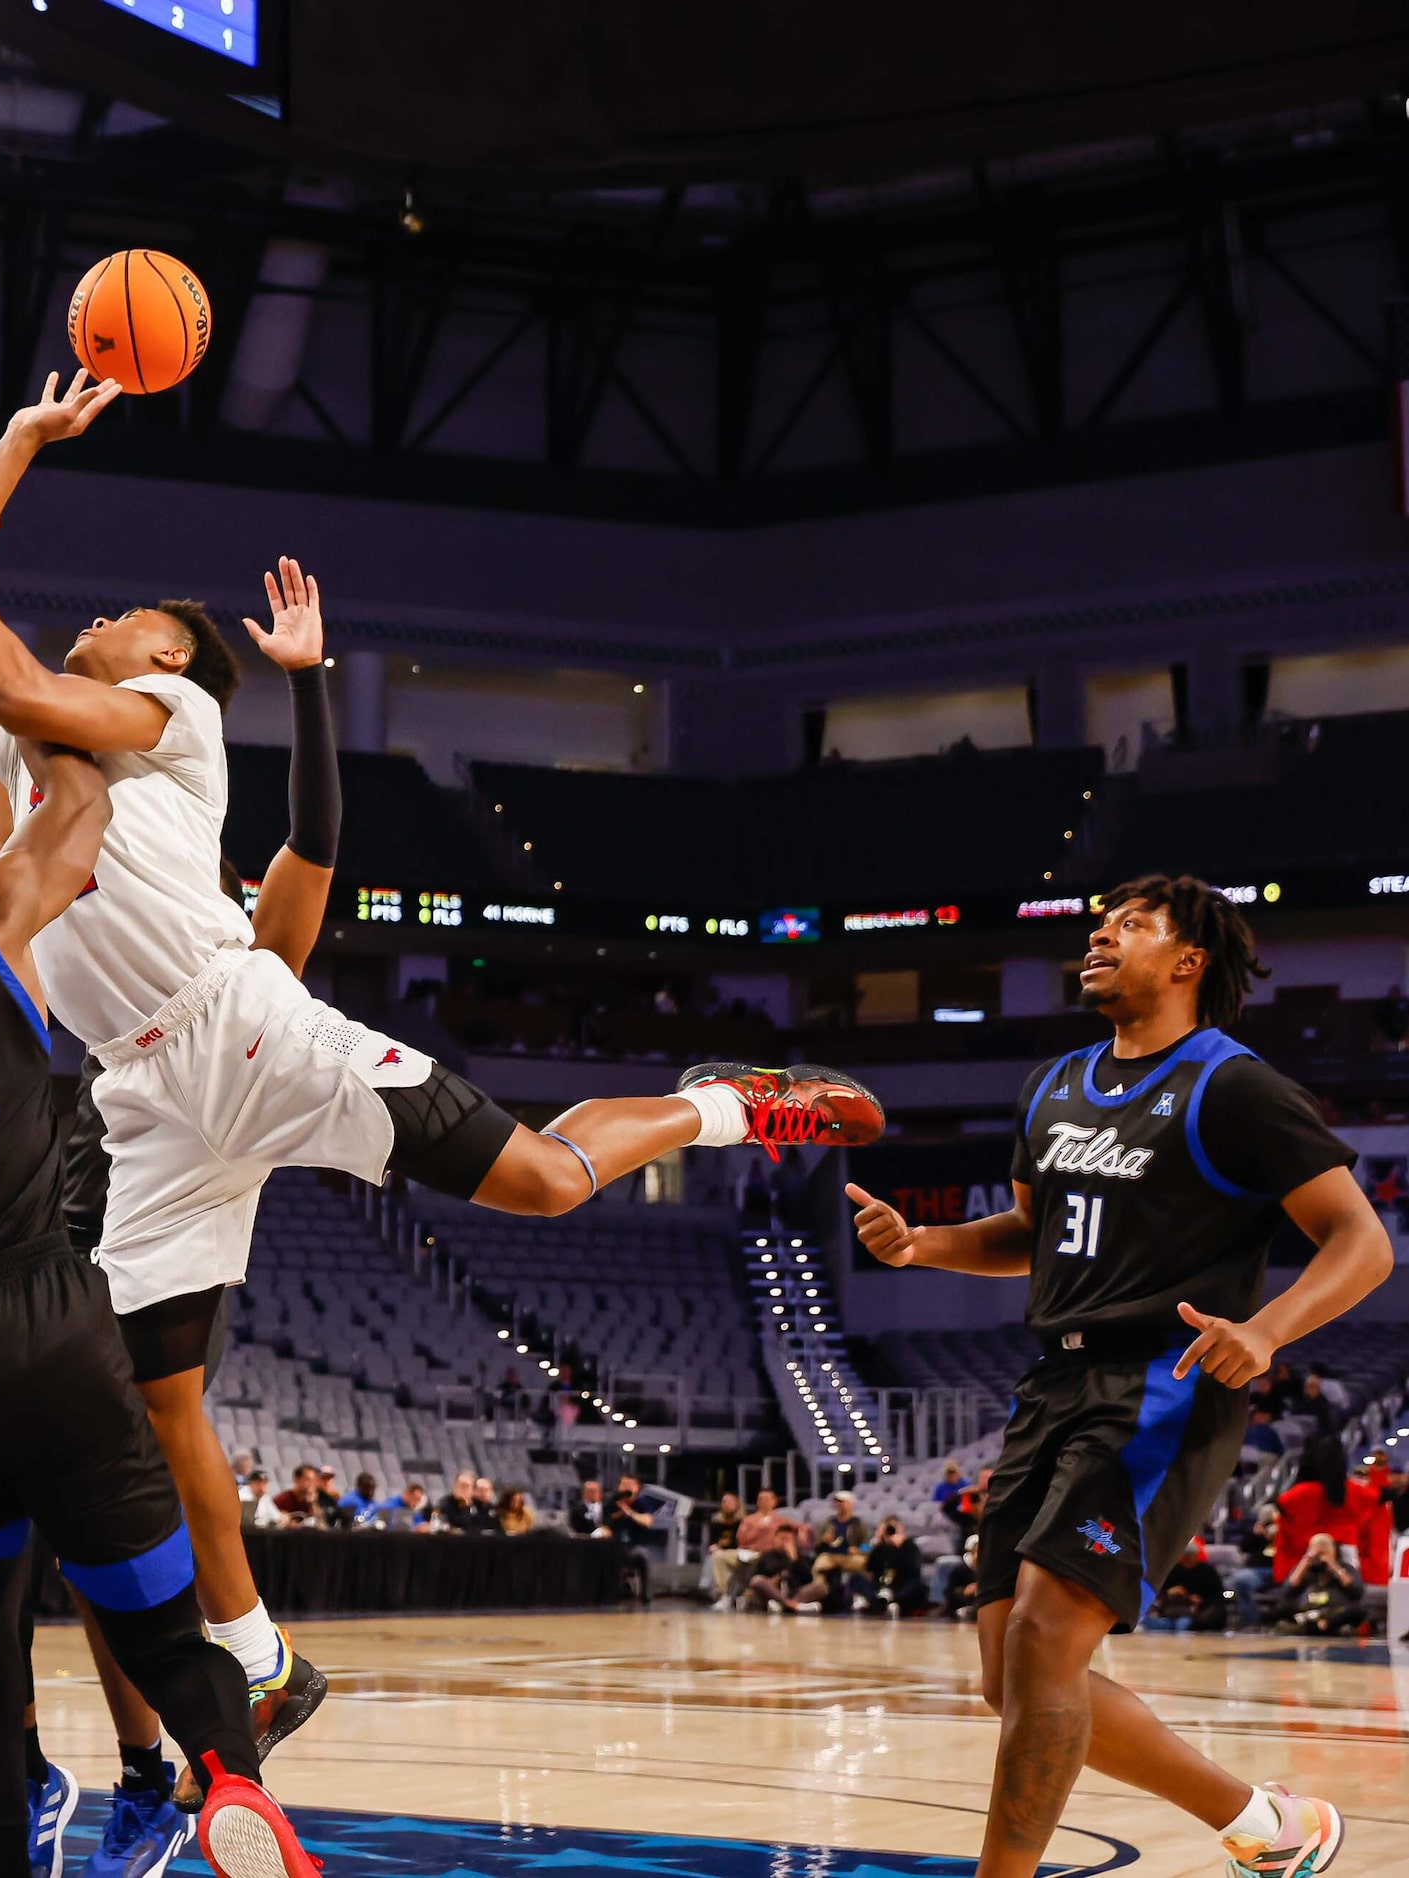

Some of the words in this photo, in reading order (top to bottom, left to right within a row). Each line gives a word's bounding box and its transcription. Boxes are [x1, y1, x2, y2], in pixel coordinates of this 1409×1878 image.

[171, 6, 184, 30] 2
[223, 28, 233, 50] 1
[371, 905, 402, 922] PTS
[433, 909, 462, 926] FLS
[659, 915, 689, 932] PTS
[719, 919, 749, 936] FLS
[135, 1027, 164, 1048] SMU
[1036, 1121, 1154, 1179] Tulsa
[1057, 1193, 1103, 1257] 31
[1076, 1519, 1121, 1554] Tulsa
